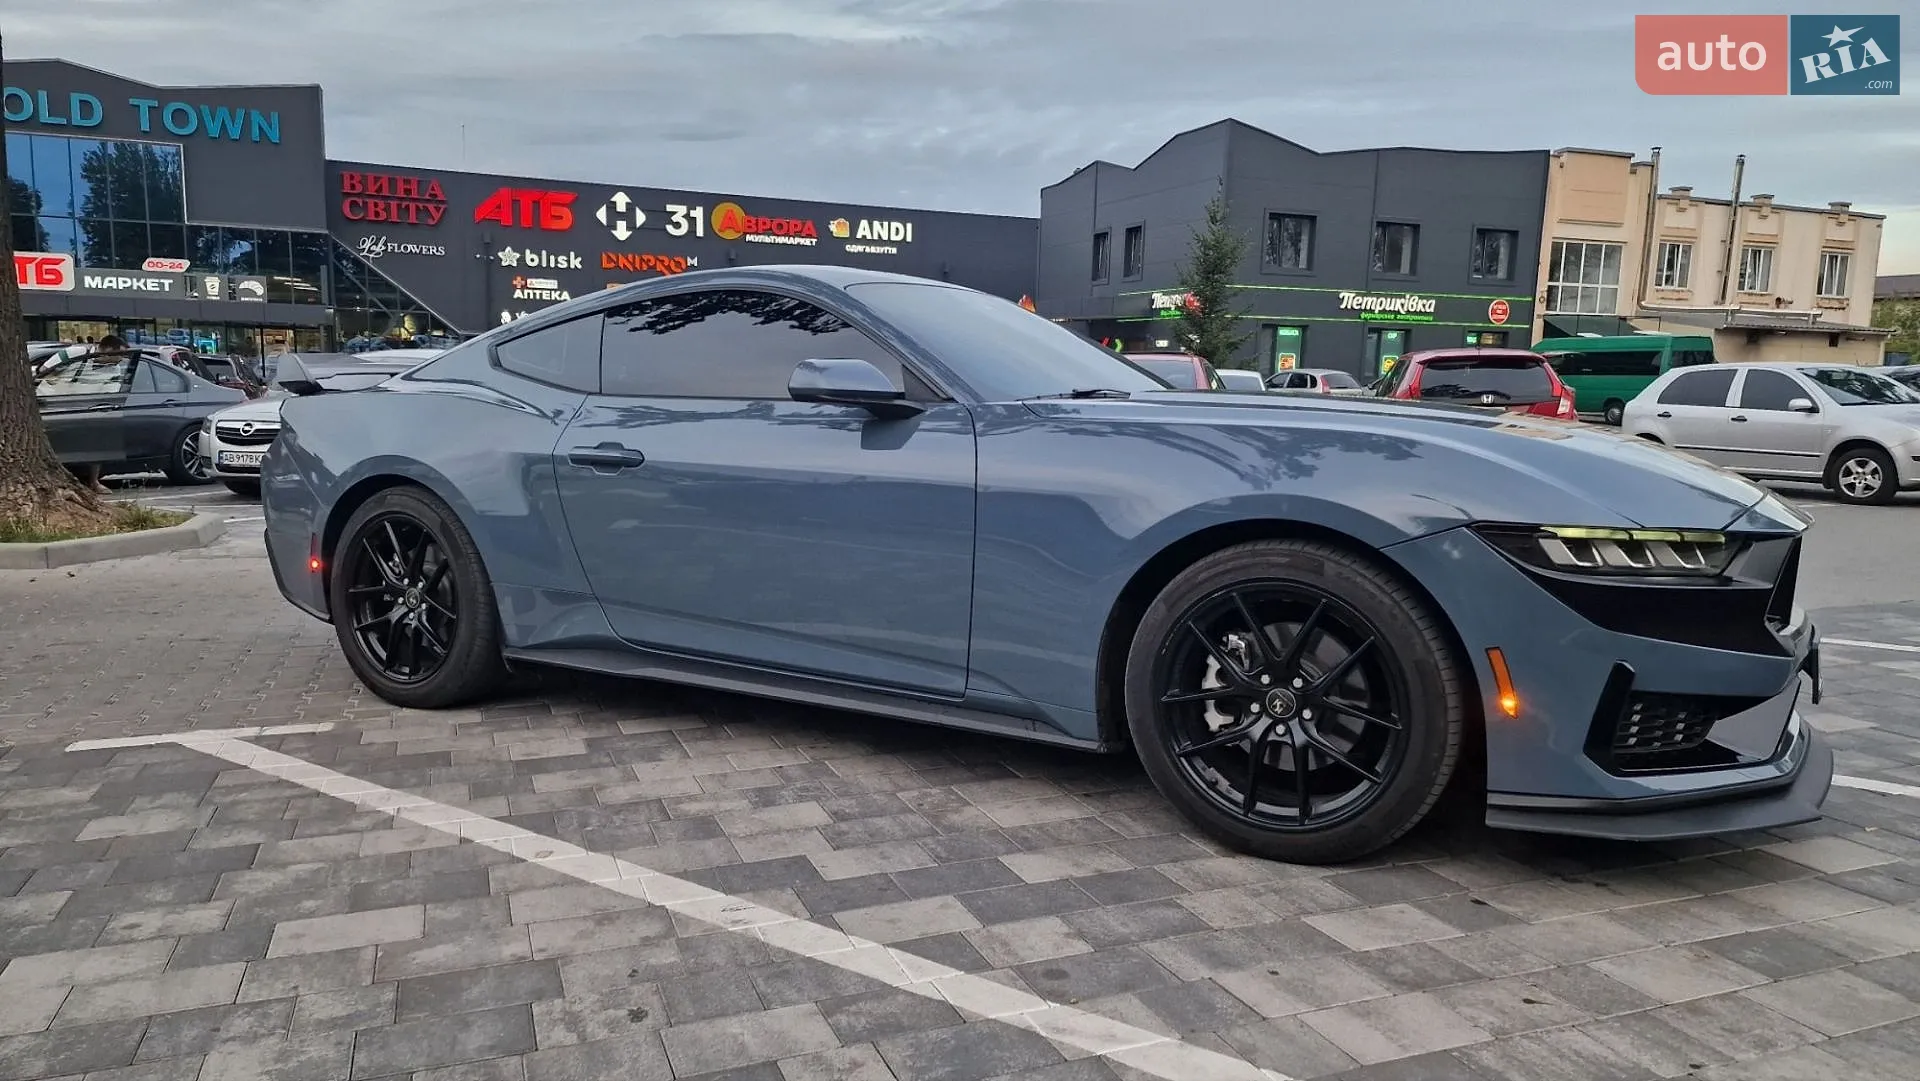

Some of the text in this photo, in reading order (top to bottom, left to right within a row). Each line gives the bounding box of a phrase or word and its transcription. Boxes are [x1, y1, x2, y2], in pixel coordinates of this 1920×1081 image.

[4, 86, 281, 144] OLD TOWN
[342, 171, 447, 201] ВИНА
[342, 198, 447, 226] СВІТУ
[474, 187, 578, 231] АТБ
[664, 203, 704, 237] 31
[745, 234, 818, 247] МУЛЬТИМАРКЕТ
[856, 219, 913, 242] ANDI
[387, 242, 445, 257] FLOWERS
[525, 249, 583, 269] blisk
[14, 256, 174, 292] ТБ МАРКЕТ
[147, 260, 185, 271] 00-24
[513, 289, 571, 301] АПТЕКА
[1339, 292, 1436, 314] Петриківка
